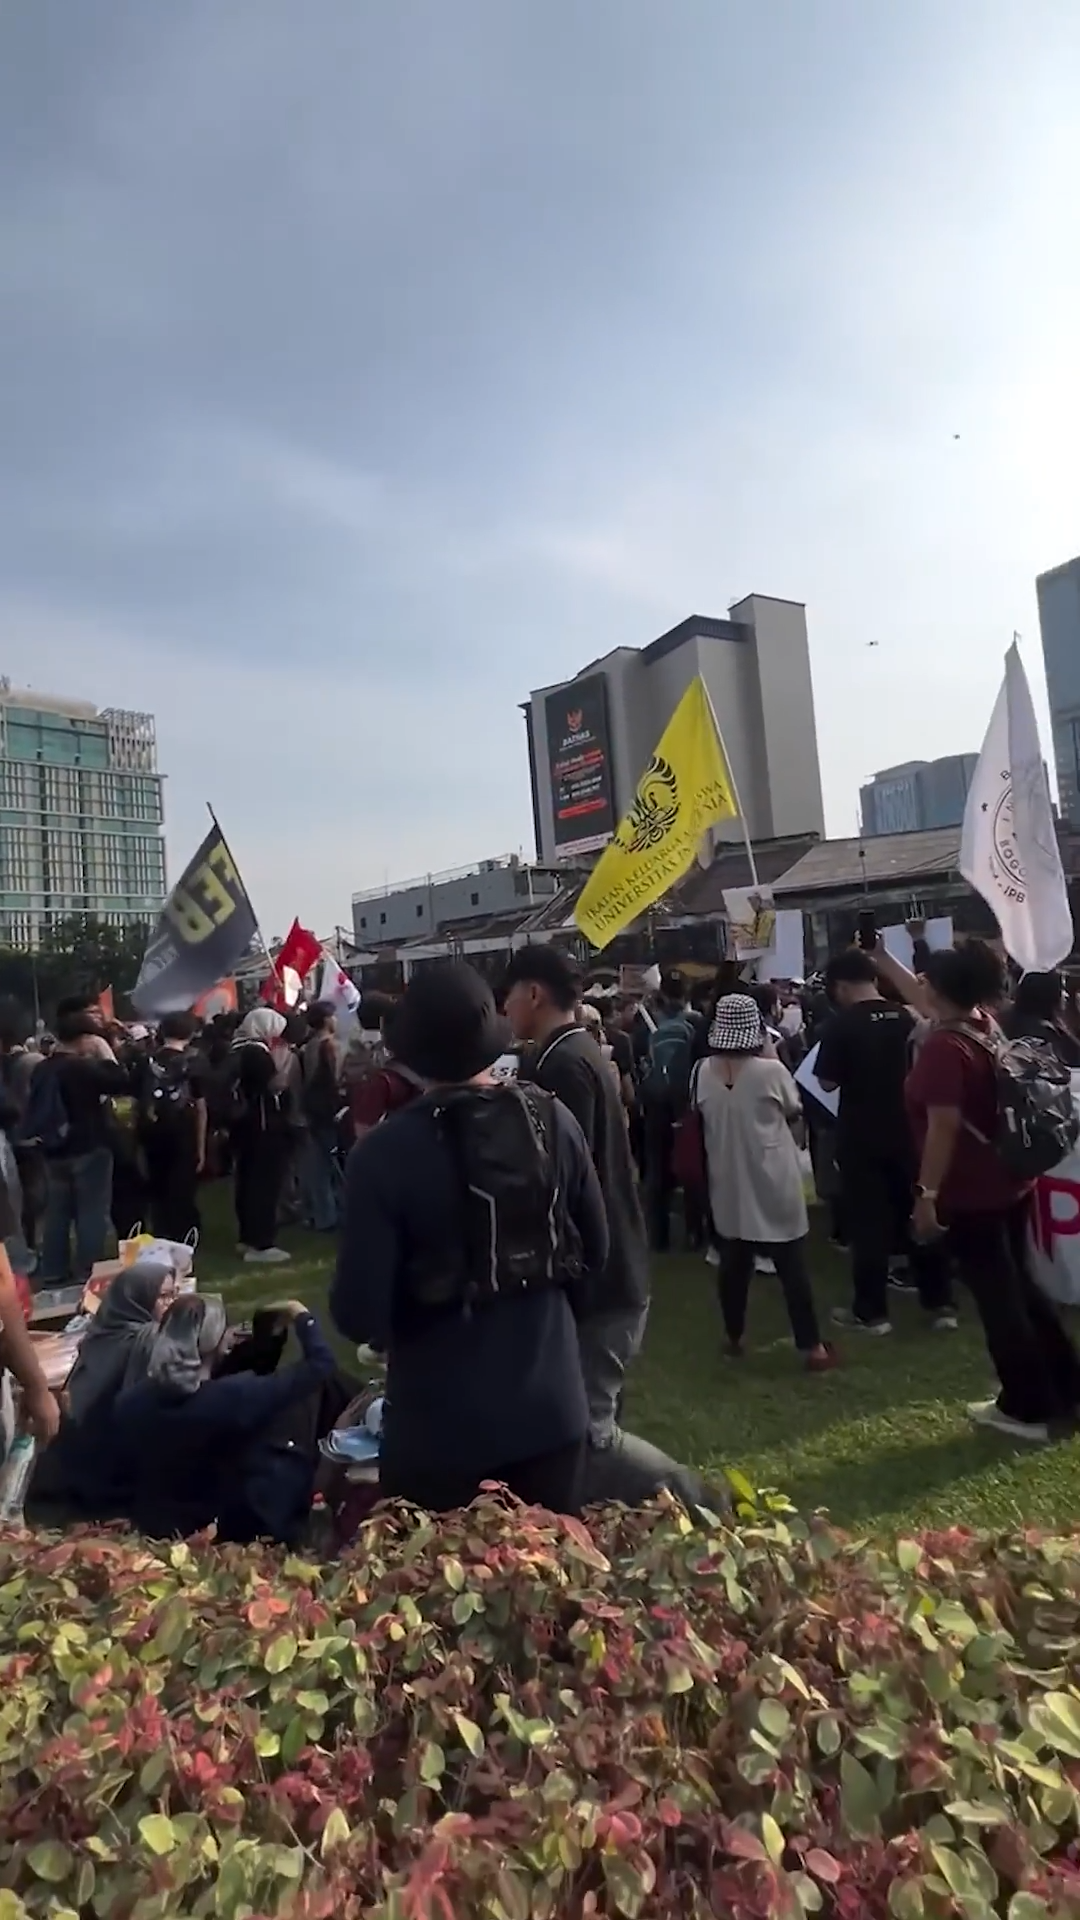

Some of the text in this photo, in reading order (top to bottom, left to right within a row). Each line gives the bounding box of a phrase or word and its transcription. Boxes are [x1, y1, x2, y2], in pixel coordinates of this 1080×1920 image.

[585, 881, 625, 921] IKATAN
[625, 837, 683, 884] KELUARGA
[999, 839, 1028, 877] BOGO
[594, 857, 677, 932] UNIVERSITAS
[1003, 886, 1026, 903] IPB
